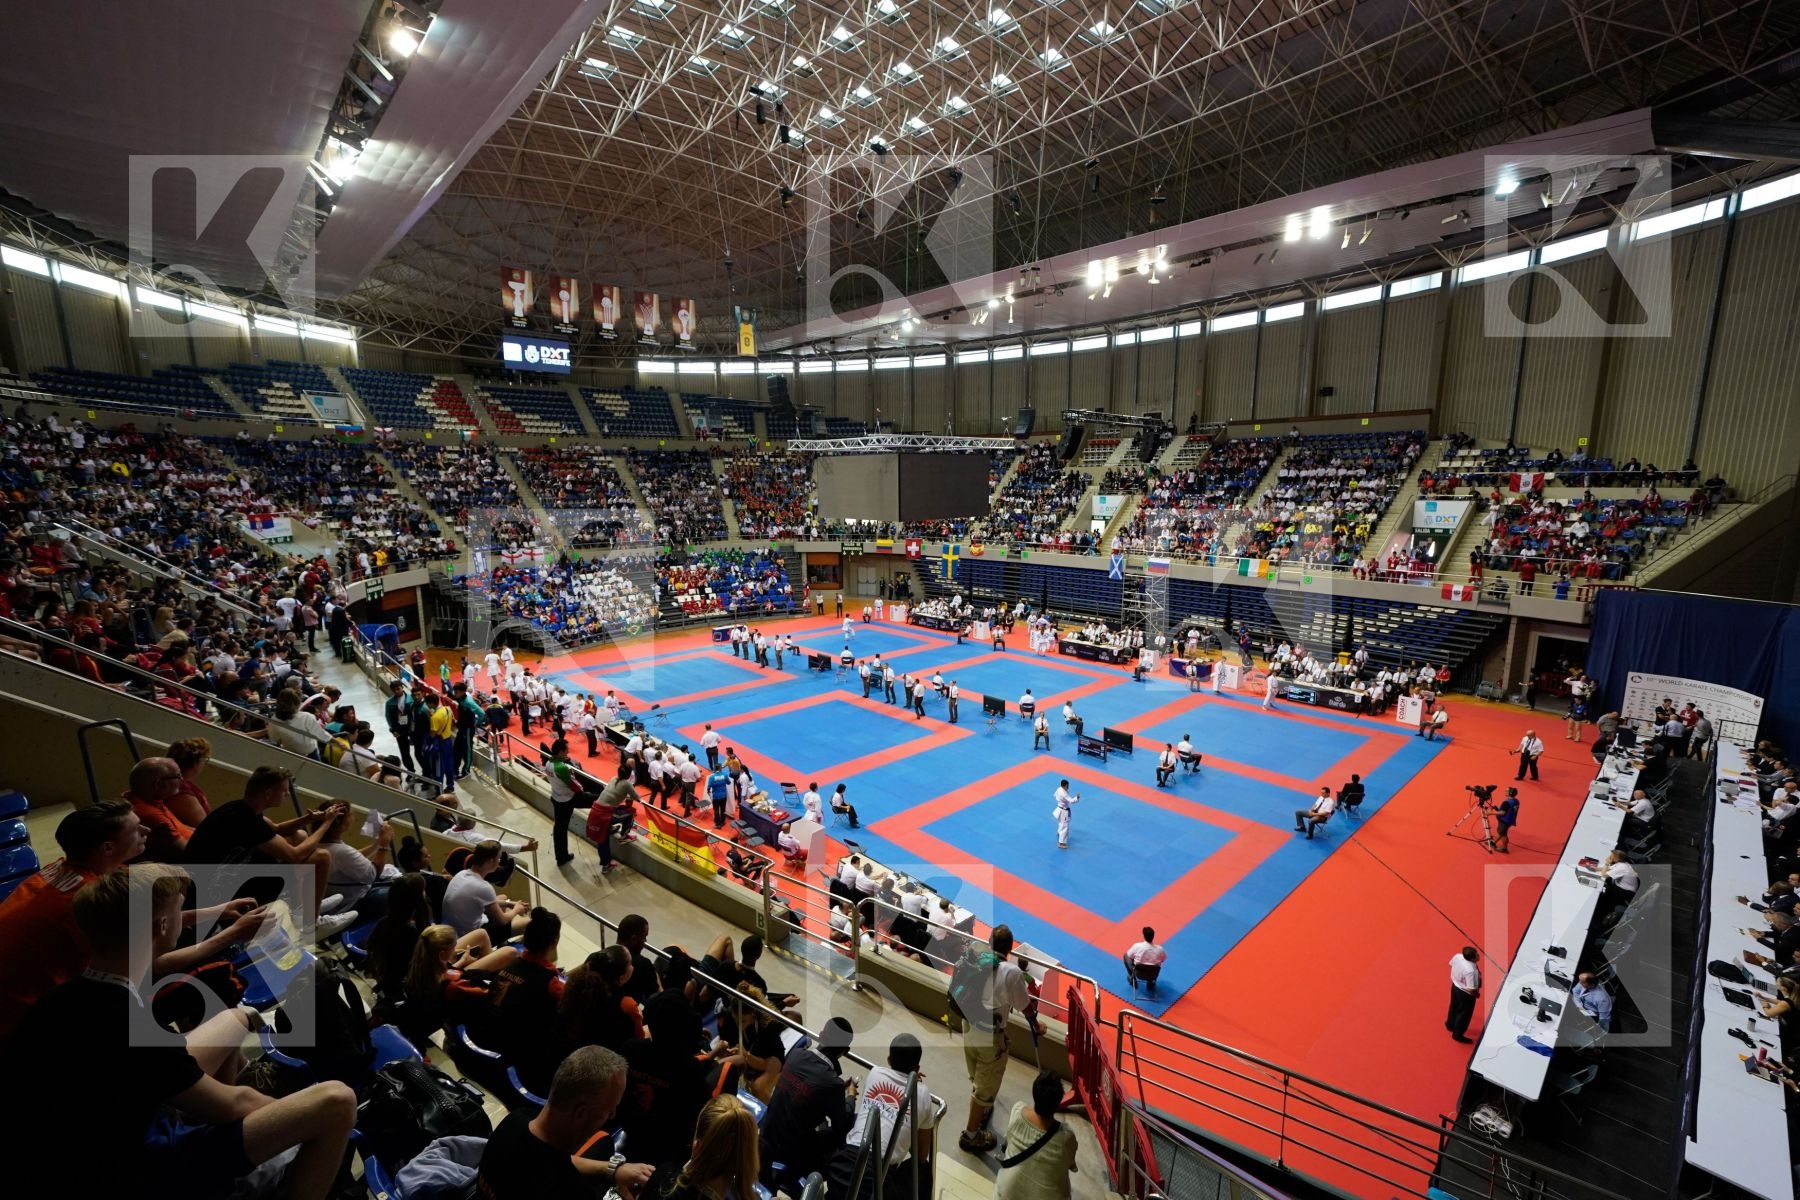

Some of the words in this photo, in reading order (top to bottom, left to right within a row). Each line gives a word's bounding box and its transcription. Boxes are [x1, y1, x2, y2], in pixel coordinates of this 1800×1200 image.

[540, 346, 570, 360] DXT
[1436, 516, 1458, 524] DXT
[1658, 678, 1683, 686] WORLD
[1684, 682, 1708, 690] KARATE
[758, 912, 764, 928] B
